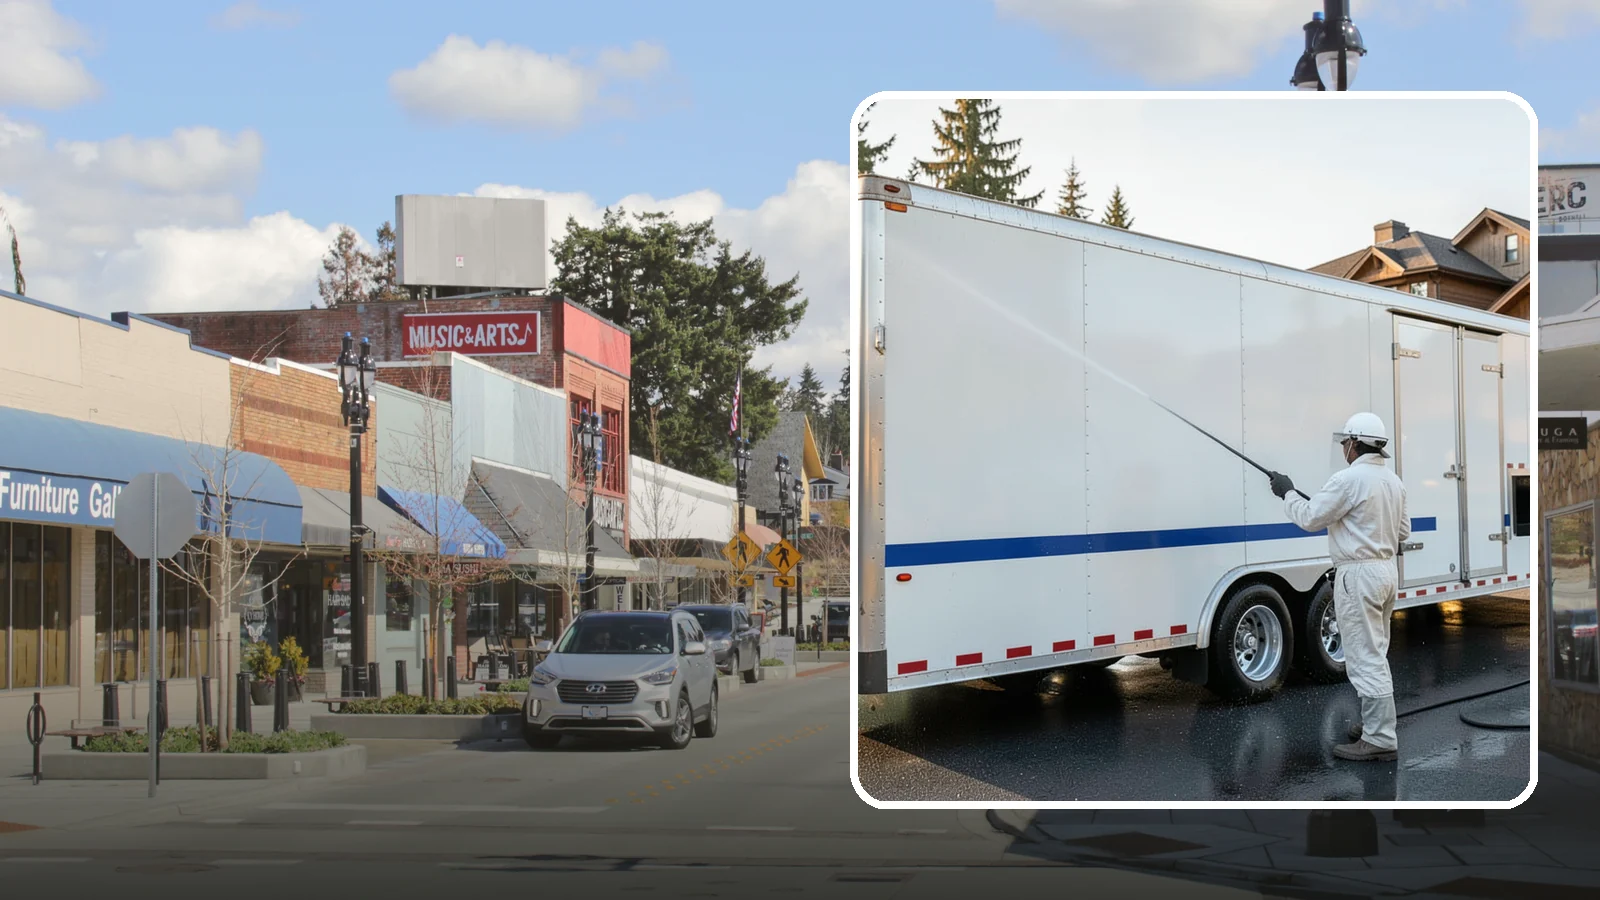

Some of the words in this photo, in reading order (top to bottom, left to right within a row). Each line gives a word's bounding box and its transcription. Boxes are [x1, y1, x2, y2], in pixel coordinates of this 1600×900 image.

[408, 323, 519, 349] MUSIC&ARTS
[0, 471, 79, 515] Furniture
[90, 482, 122, 519] Gal
[453, 563, 479, 573] SUSHI
